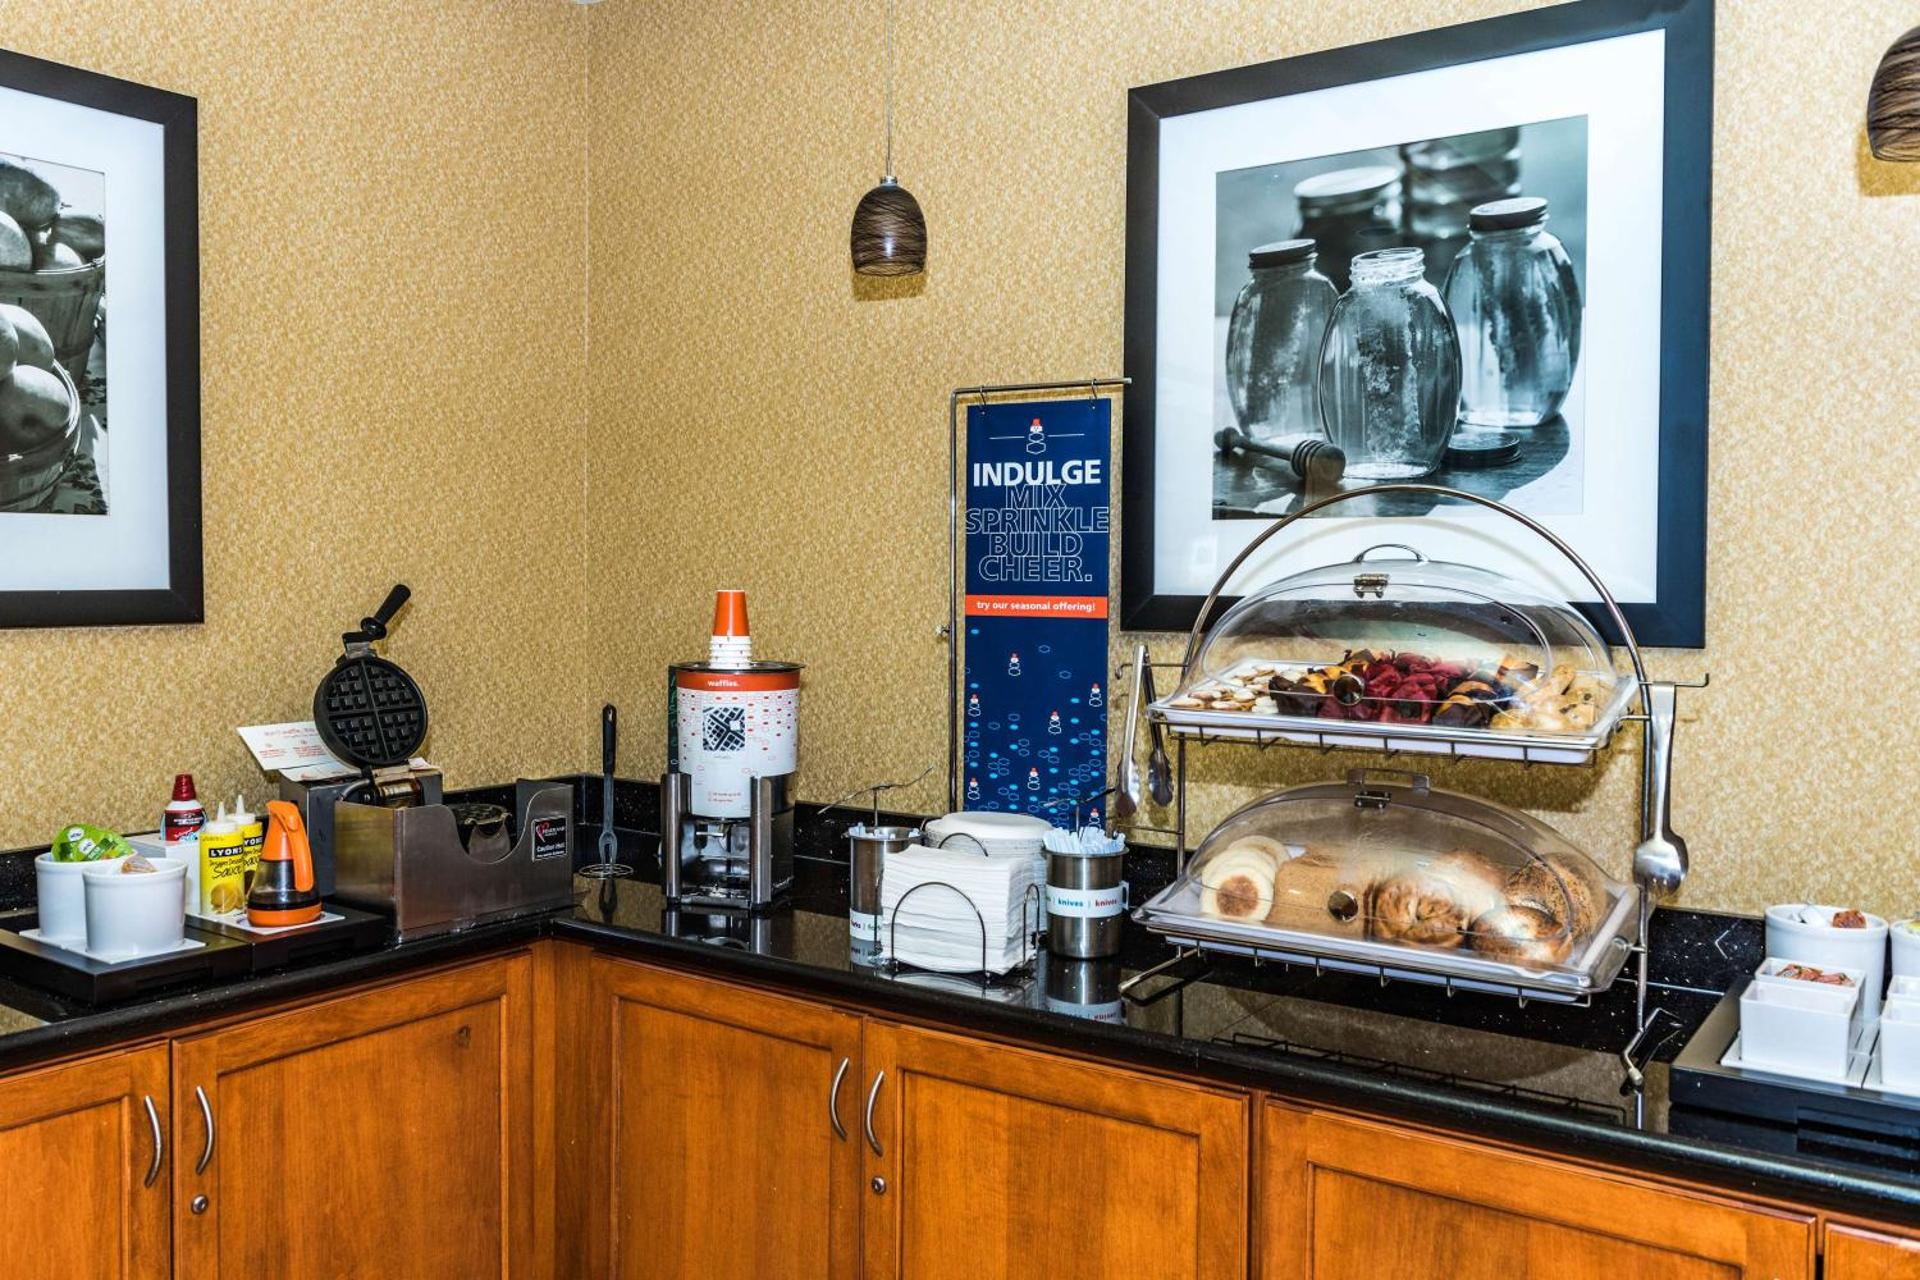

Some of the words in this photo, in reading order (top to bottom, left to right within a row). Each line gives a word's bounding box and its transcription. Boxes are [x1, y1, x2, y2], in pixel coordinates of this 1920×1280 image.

[973, 459, 1101, 487] INDULGE
[1005, 484, 1067, 509] MIX
[966, 507, 1109, 534] SPRINKLE
[989, 532, 1083, 558] BUILD
[978, 555, 1093, 582] CHEER.
[976, 601, 990, 611] try
[992, 601, 1008, 609] our
[1010, 601, 1051, 610] seasonal
[1053, 601, 1096, 613] offering!
[210, 847, 242, 857] LYONS
[212, 866, 243, 880] Sauce
[1058, 898, 1083, 907] knives
[1095, 899, 1117, 907] knives
